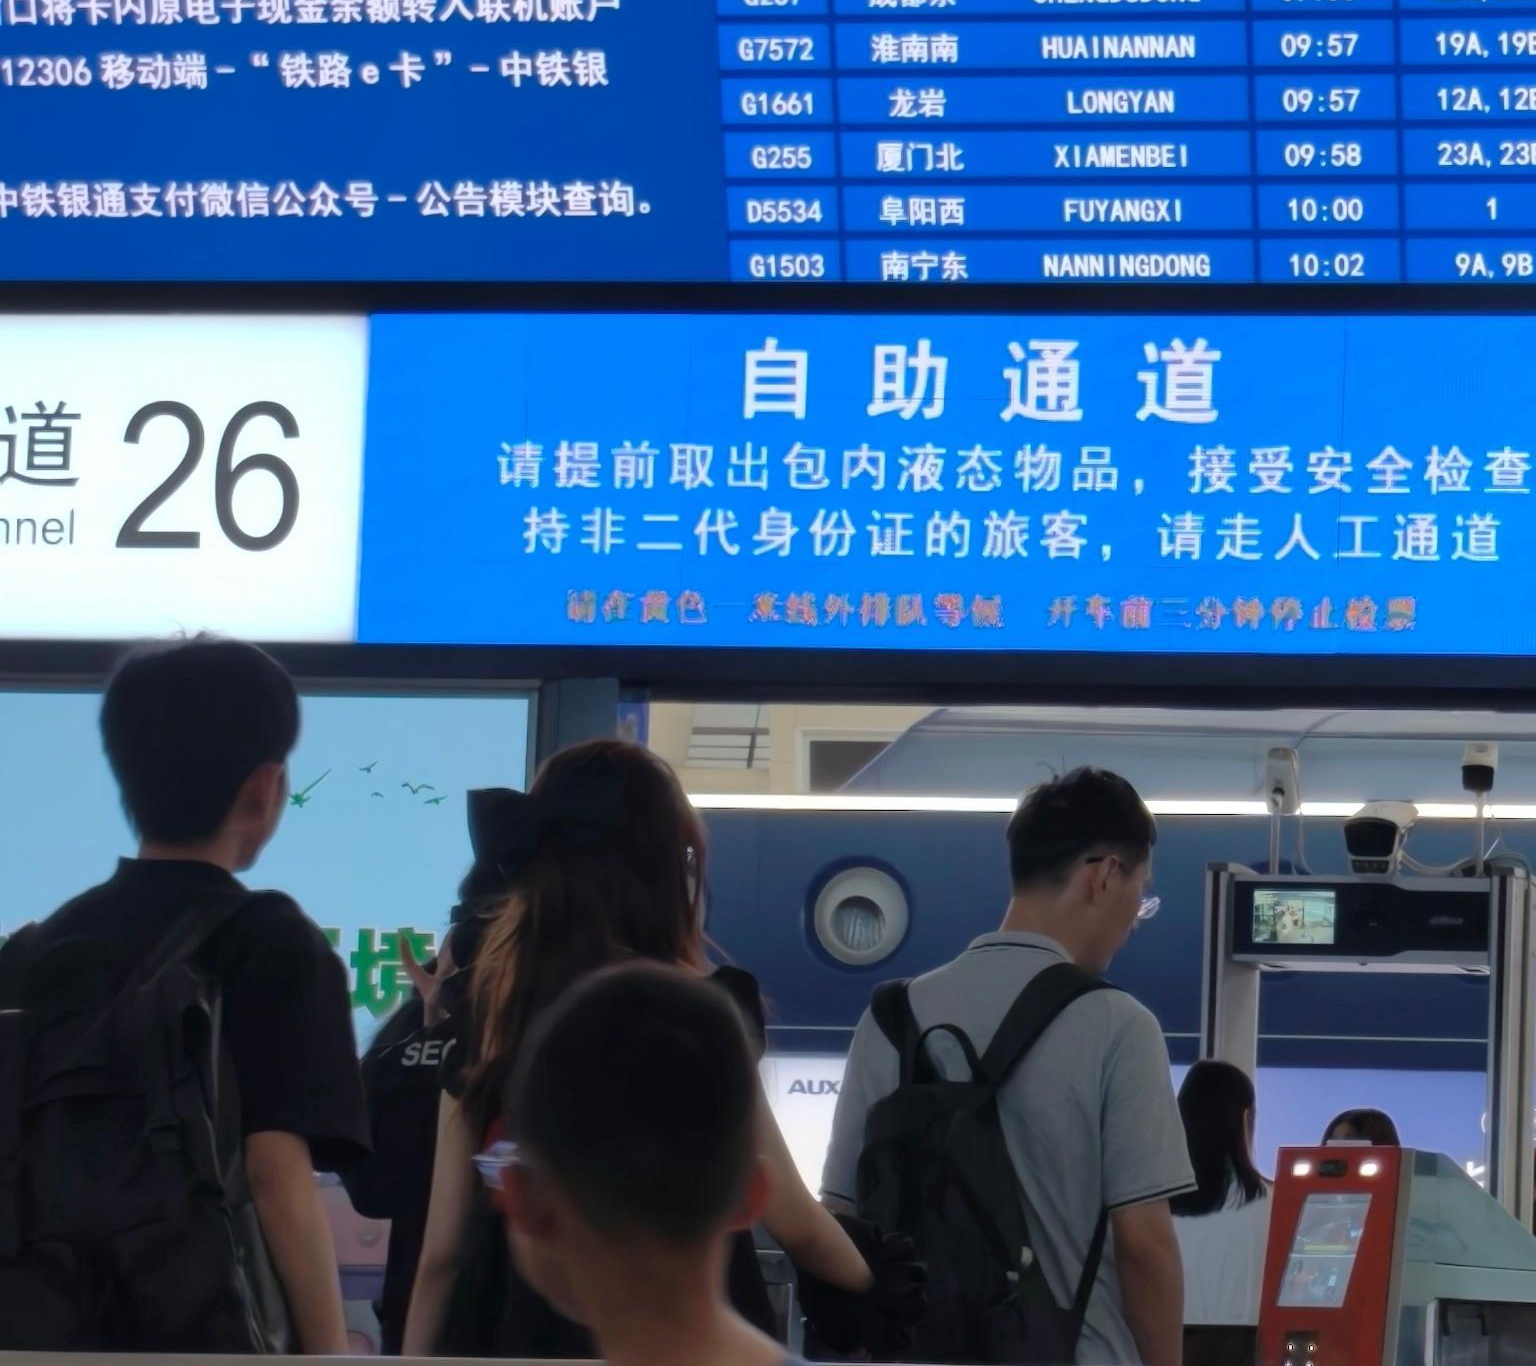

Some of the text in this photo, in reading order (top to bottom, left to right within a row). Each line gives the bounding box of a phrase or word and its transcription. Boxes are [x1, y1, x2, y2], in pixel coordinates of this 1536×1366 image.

[738, 37, 813, 61] G7572
[872, 34, 957, 62] 淮南南
[1042, 35, 1195, 58] HUAINANNAN
[1281, 34, 1358, 57] 09:57
[742, 93, 812, 115] G1661
[889, 89, 945, 117] 龙岩
[1068, 90, 1174, 113] LONGYAN
[1283, 89, 1360, 112] 09:57
[752, 146, 811, 168] G255
[877, 143, 964, 171] 厦门北
[1056, 145, 1186, 167] XIAMENBEI
[1285, 143, 1361, 166] 09:58
[747, 200, 822, 222] D5534
[880, 196, 964, 225] 阜阳西
[1064, 199, 1180, 222] FUYANGXI
[1289, 198, 1363, 221] 10:00
[1487, 198, 1496, 219] 1
[750, 255, 824, 277] G1503
[882, 251, 967, 280] 南宁东
[1044, 254, 1210, 277] NANNINGDONG
[1290, 253, 1364, 276] 10:02
[743, 337, 1221, 422] 自助通道
[0, 400, 300, 552] 道 26
[788, 1079, 841, 1095] AUX
